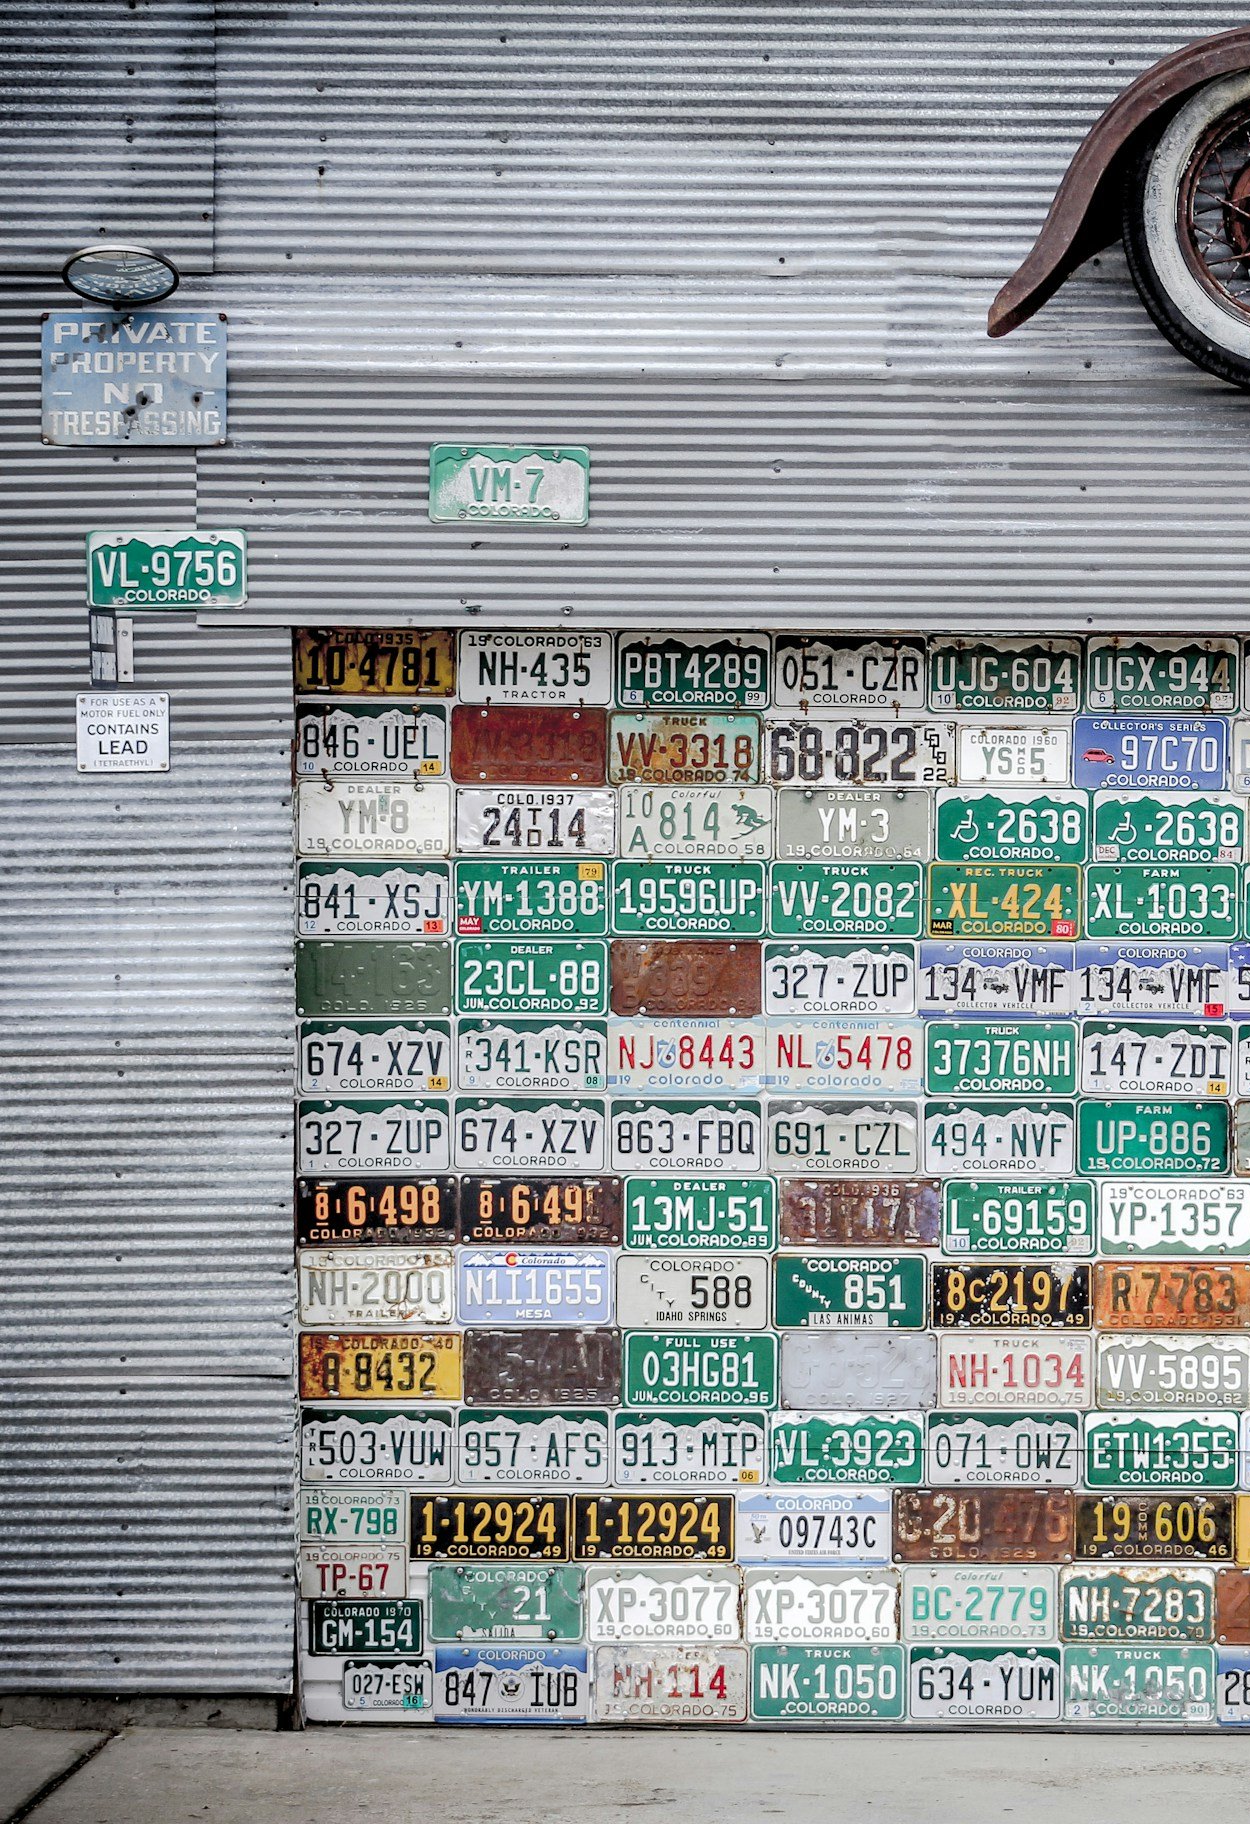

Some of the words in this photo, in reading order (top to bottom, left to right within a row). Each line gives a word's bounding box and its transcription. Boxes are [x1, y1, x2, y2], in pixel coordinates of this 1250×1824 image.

[53, 322, 216, 344] PRIVATE
[50, 352, 219, 374] PROPERTY
[467, 504, 552, 517] COLORADO
[125, 589, 211, 602] COLORADO
[492, 635, 578, 648] COLORADO
[625, 653, 762, 689] PBT4289
[503, 690, 566, 699] TRACTOR
[90, 698, 108, 706] FOR
[112, 698, 132, 706] USE
[133, 698, 147, 706] AS
[150, 698, 156, 706] A
[81, 710, 113, 718] MOTOR
[143, 709, 165, 717] ONLY
[664, 716, 707, 726] TRUCK
[1169, 722, 1207, 732] SERIES
[88, 724, 158, 735] CONTAINS
[971, 735, 1027, 746] COLORADO
[1033, 735, 1058, 746] 1960
[99, 740, 148, 755] LEAD
[1121, 736, 1218, 772] 97C70
[661, 802, 720, 841] 814
[502, 865, 561, 875] TRAILER
[1000, 868, 1043, 878] TRUCK
[620, 880, 756, 916] 19596UP
[511, 946, 553, 955] DEALER
[962, 946, 1032, 959] COLORADO
[925, 968, 977, 1001] 134
[1014, 969, 1066, 1002] VMF
[654, 1018, 720, 1028] centennial
[679, 1035, 755, 1069] 8443
[934, 1040, 1071, 1077] 37376NH
[521, 1256, 566, 1265] Colorado
[690, 1274, 752, 1309] 588
[844, 1274, 906, 1310] 851
[516, 1309, 552, 1319] MESA
[656, 1311, 684, 1322] IDAHO
[688, 1311, 727, 1323] SPRINGS
[814, 1313, 833, 1325] LAS
[837, 1313, 874, 1325] ANIMAS
[665, 1338, 703, 1348] FULL
[710, 1338, 736, 1348] USE
[643, 1351, 759, 1387] 03HG81
[778, 1515, 876, 1550] 09743C
[954, 1570, 1003, 1581] Colorful
